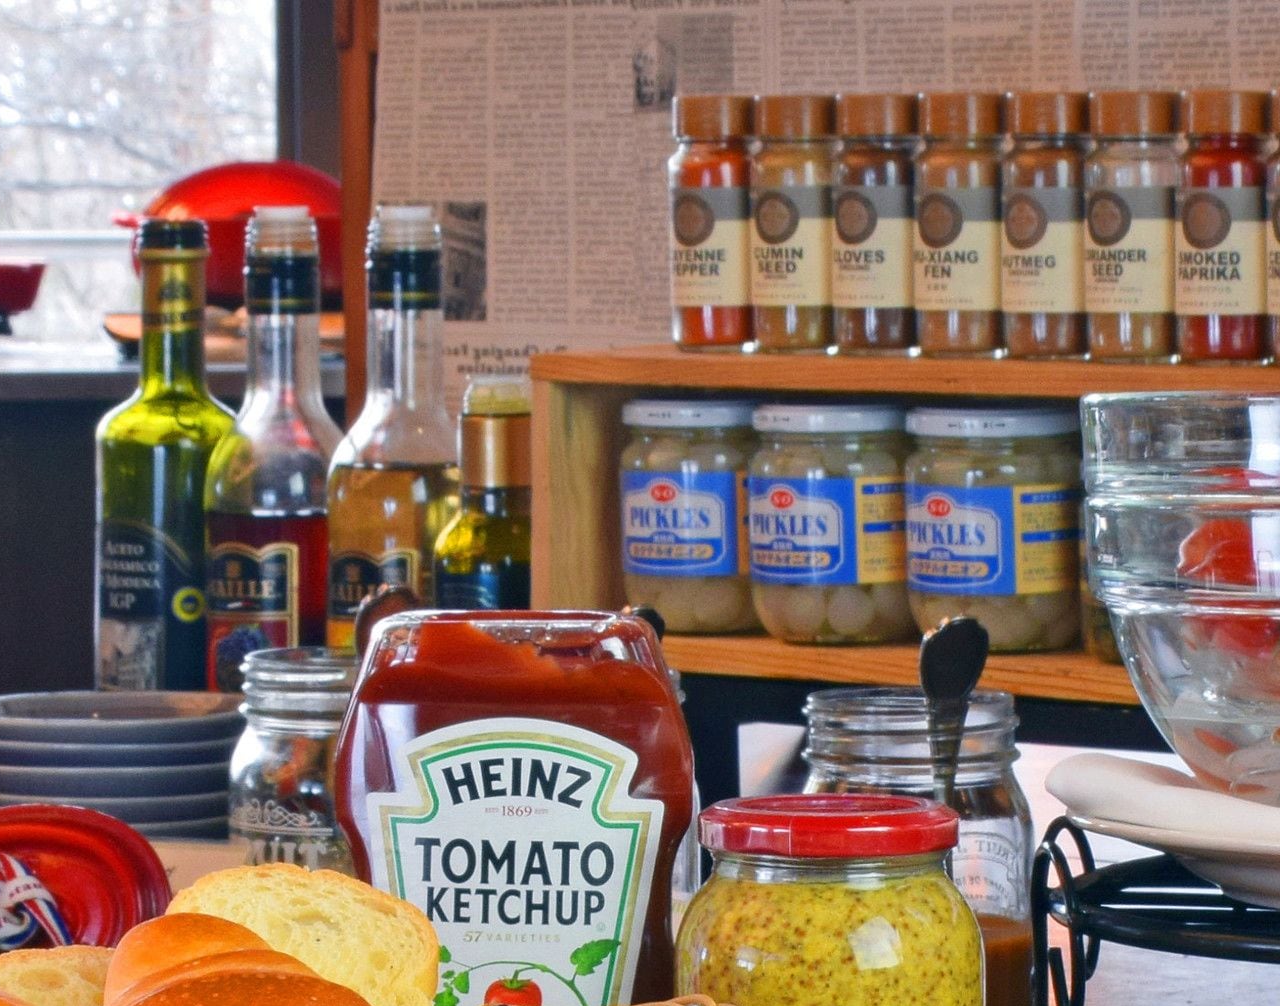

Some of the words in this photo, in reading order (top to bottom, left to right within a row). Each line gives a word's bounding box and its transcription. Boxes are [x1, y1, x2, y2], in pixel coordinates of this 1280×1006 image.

[758, 261, 797, 273] SEED
[924, 265, 952, 279] FEN
[630, 507, 711, 528] PICKLES
[752, 513, 827, 537] PICKLES
[909, 521, 986, 546] PICKLES
[441, 757, 592, 809] HEINZ
[501, 805, 533, 817] 1869
[414, 837, 615, 887] TOMATO
[426, 886, 606, 926] KETCHUP
[463, 931, 483, 943] 57
[486, 933, 561, 943] VARIETIES
